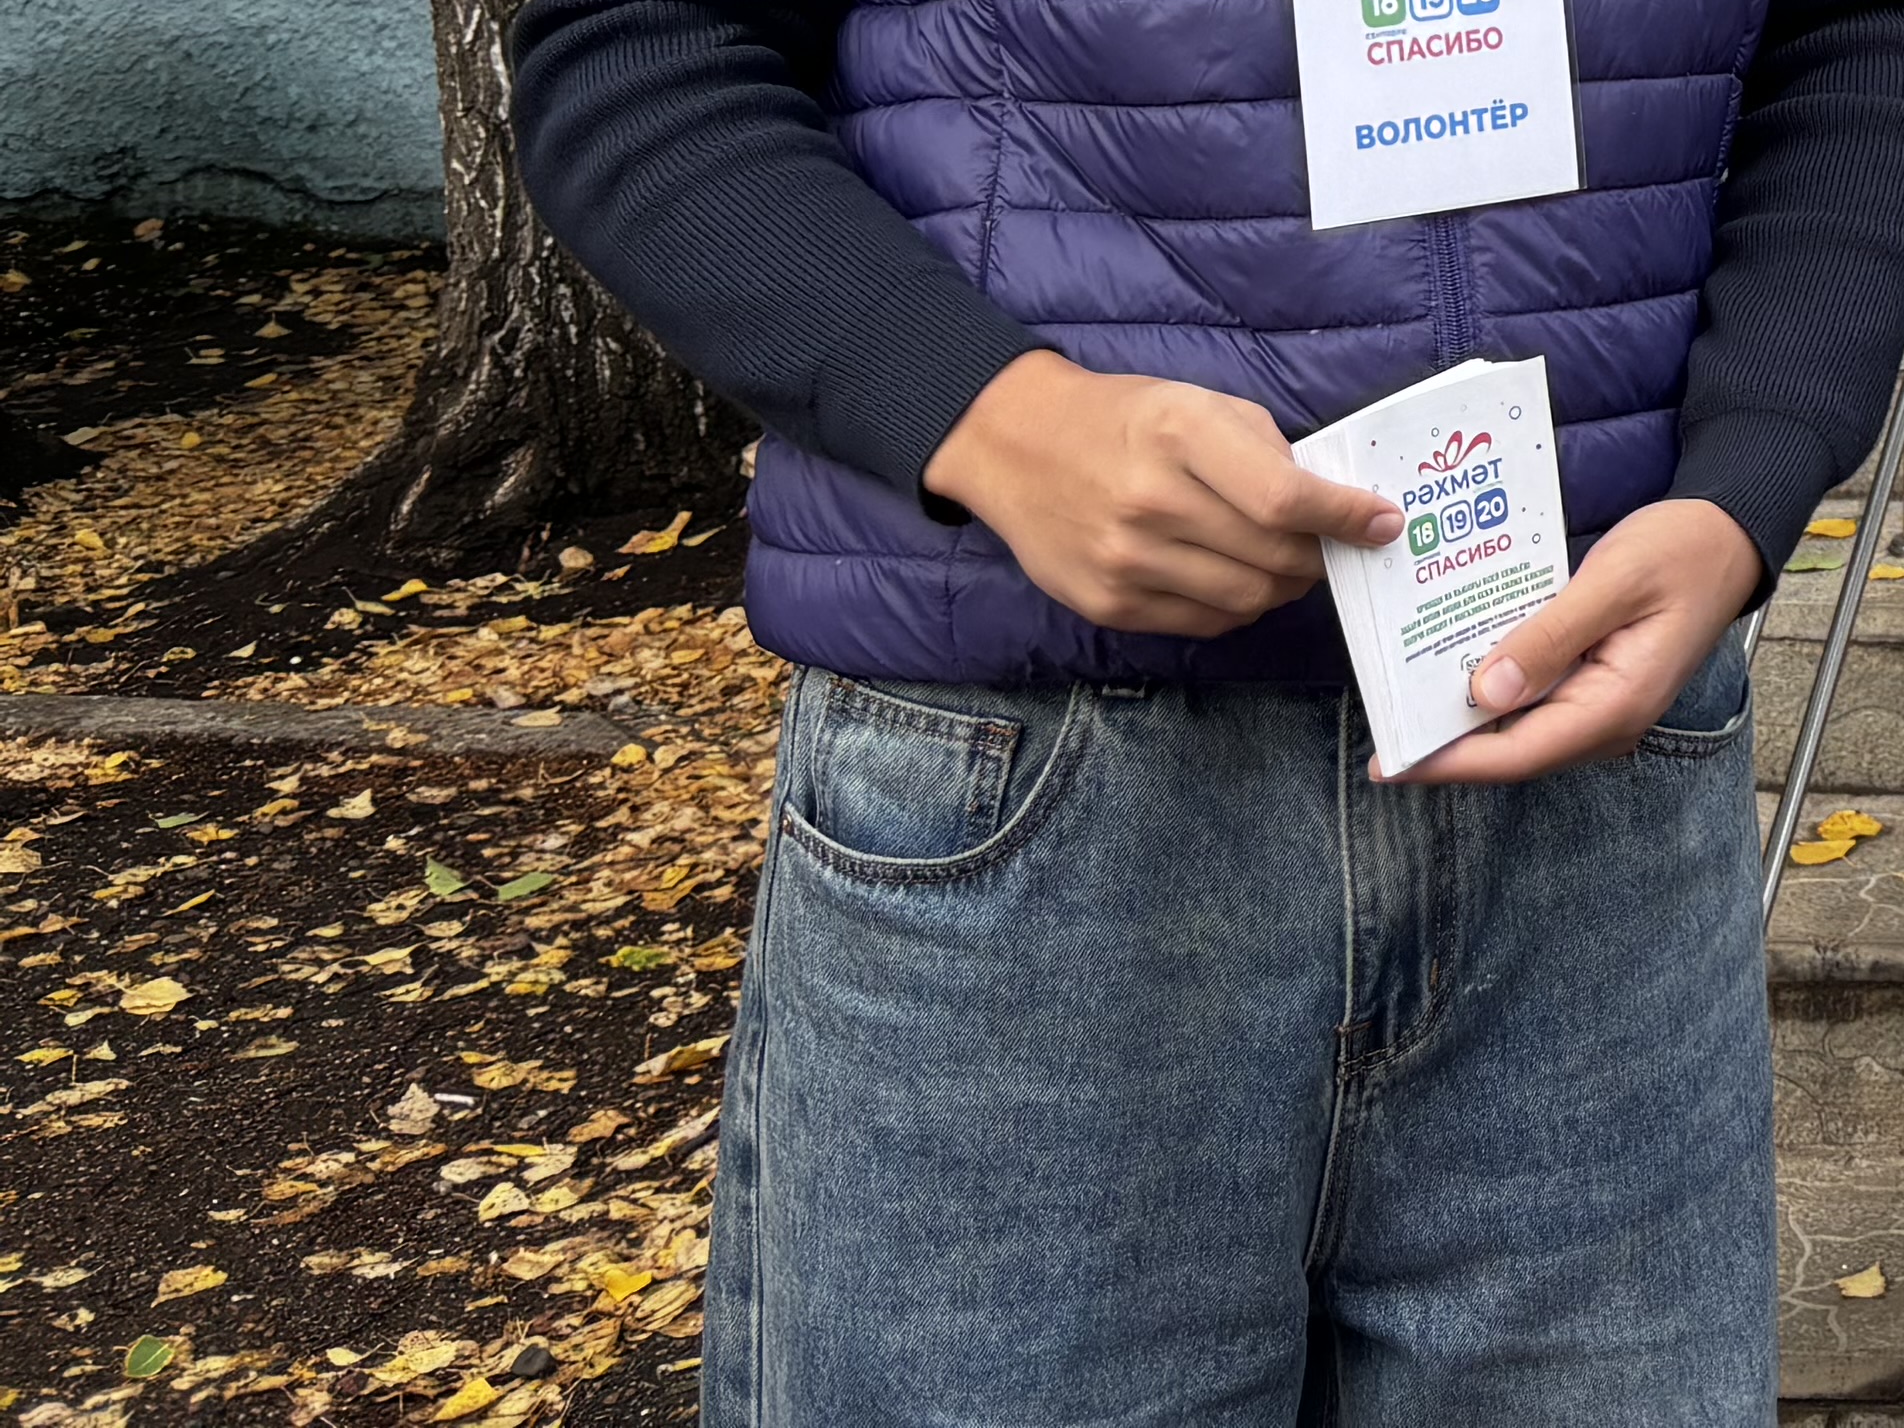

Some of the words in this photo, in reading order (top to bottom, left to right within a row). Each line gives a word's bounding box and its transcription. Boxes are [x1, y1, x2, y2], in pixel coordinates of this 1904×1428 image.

[1366, 26, 1504, 66] СПАСИБО
[1355, 98, 1530, 150] ВОЛОНТЁР
[1402, 457, 1503, 513] РӘХМӘТ
[1412, 520, 1436, 548] 18
[1446, 509, 1468, 534] 19
[1477, 495, 1506, 523] 20
[1415, 533, 1513, 585] СПАСИБО
